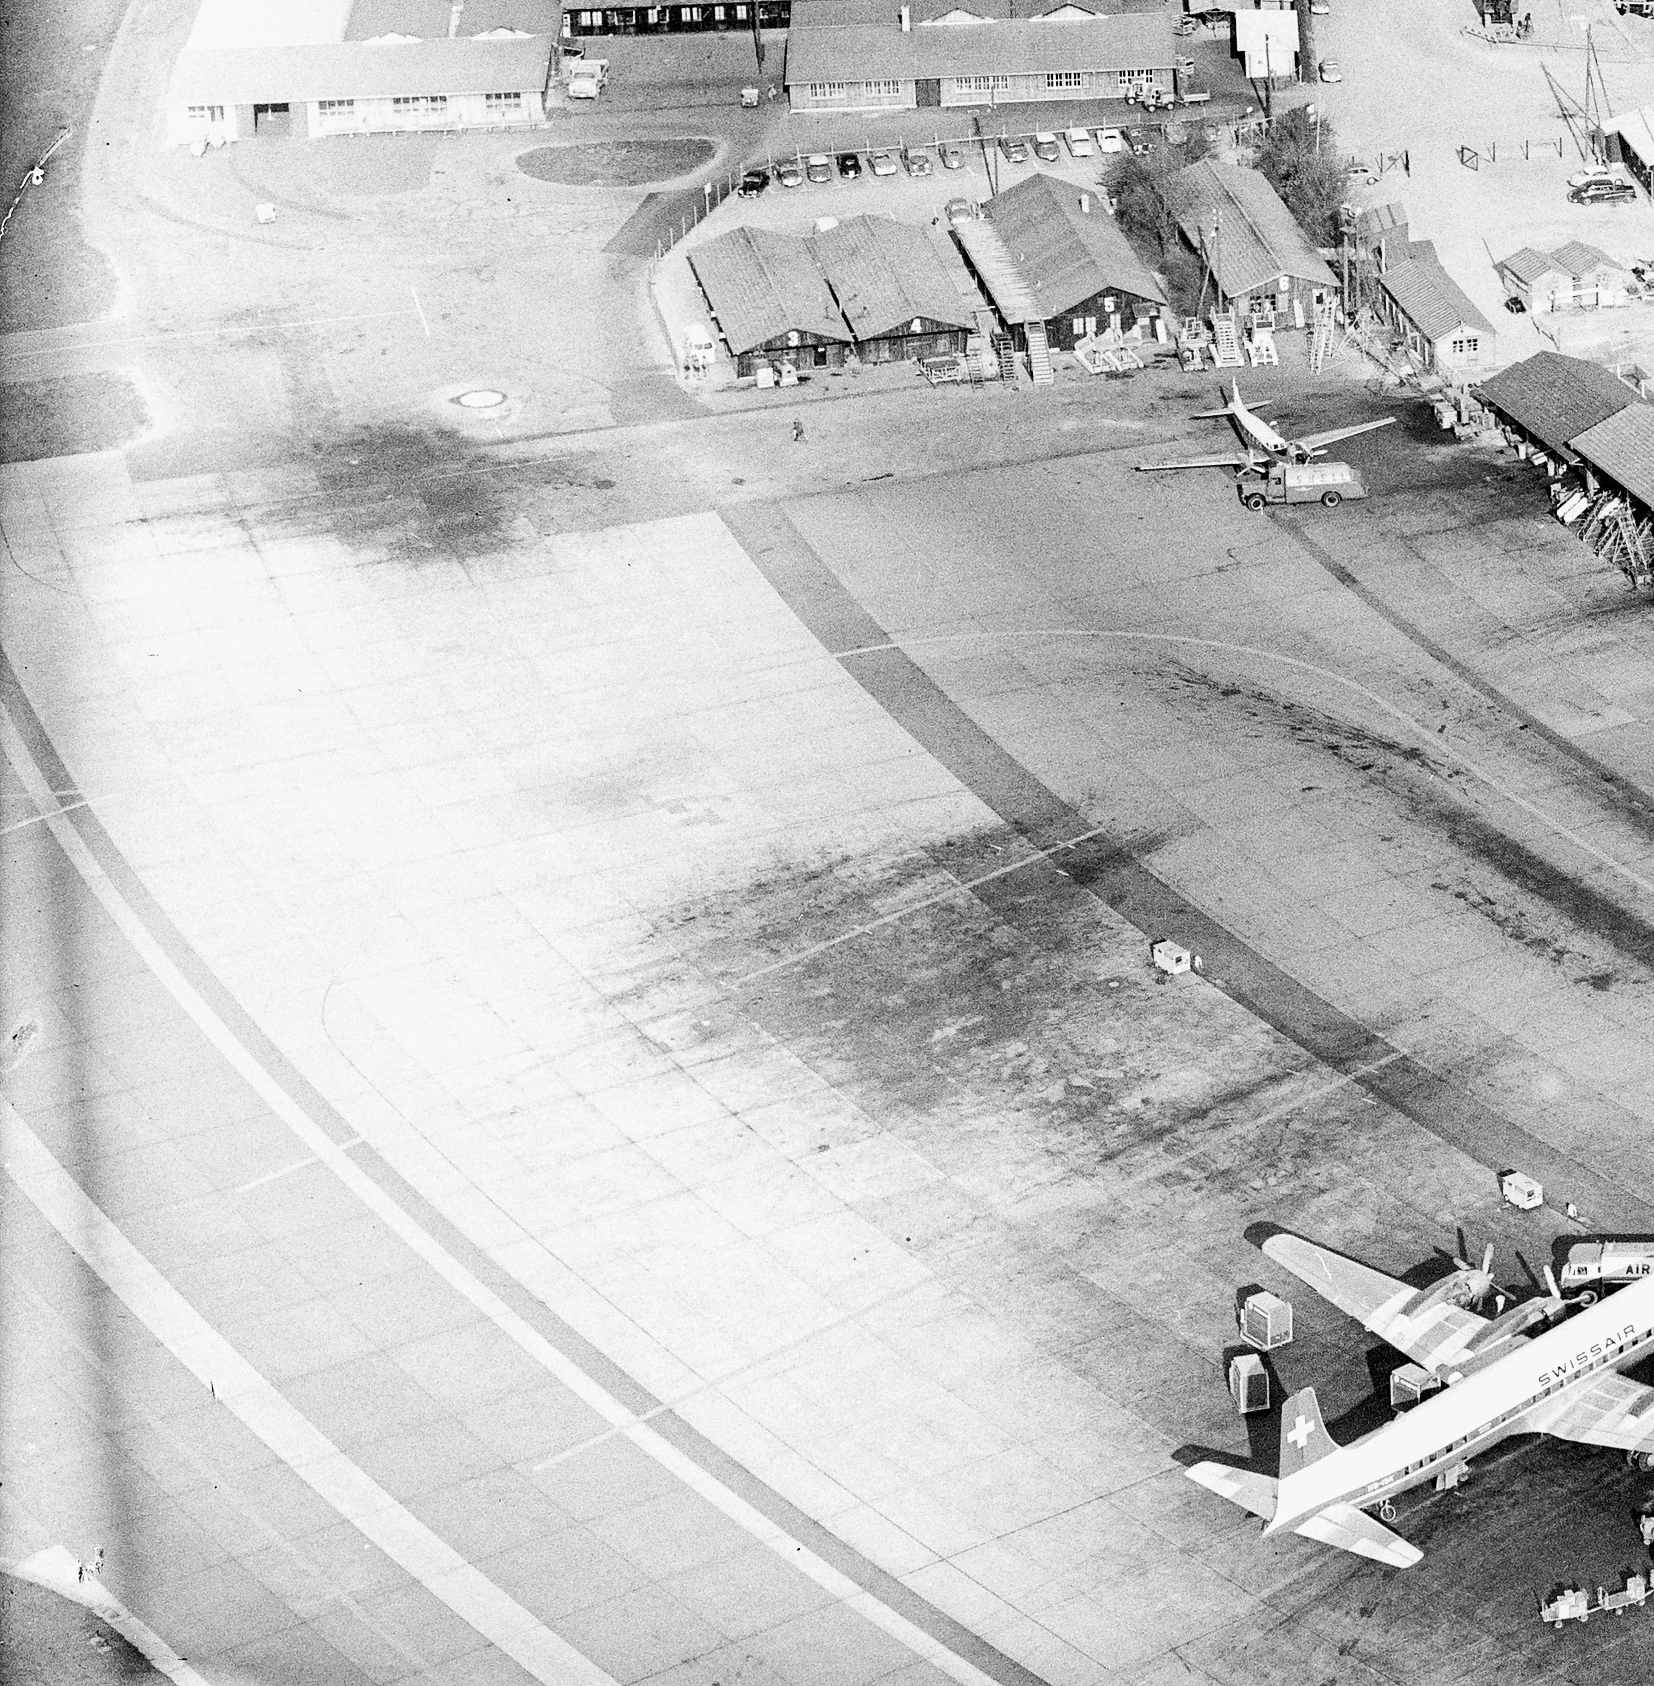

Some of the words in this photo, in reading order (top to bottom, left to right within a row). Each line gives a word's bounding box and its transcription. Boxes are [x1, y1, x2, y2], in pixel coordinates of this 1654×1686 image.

[1103, 297, 1115, 312] 5
[910, 318, 922, 333] 4
[787, 331, 799, 346] 3
[1626, 1264, 1650, 1274] AIR
[1538, 1324, 1636, 1387] SWISSAIR
